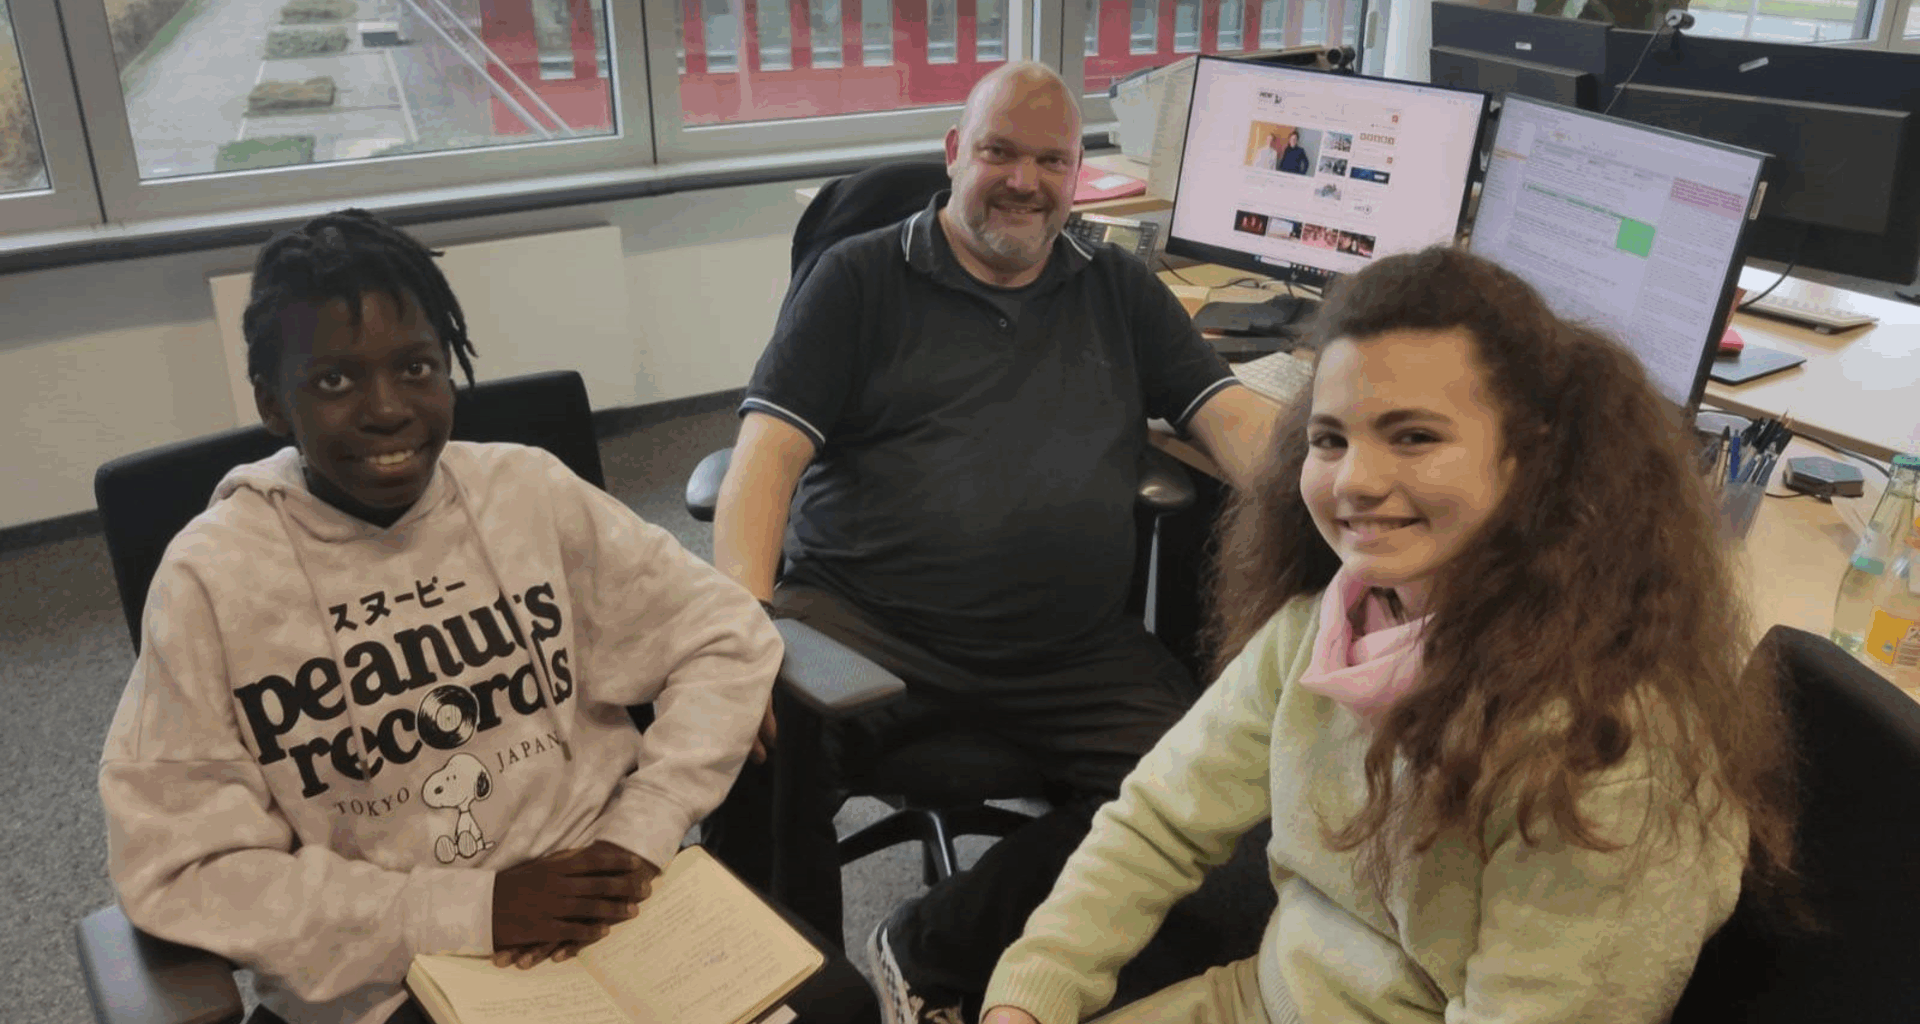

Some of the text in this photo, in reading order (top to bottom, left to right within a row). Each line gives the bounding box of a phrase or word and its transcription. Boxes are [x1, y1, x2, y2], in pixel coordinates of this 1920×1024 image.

[328, 576, 466, 633] スヌーピー
[233, 582, 563, 765] peanuts
[288, 636, 573, 799] records
[332, 787, 410, 817] TOKYO
